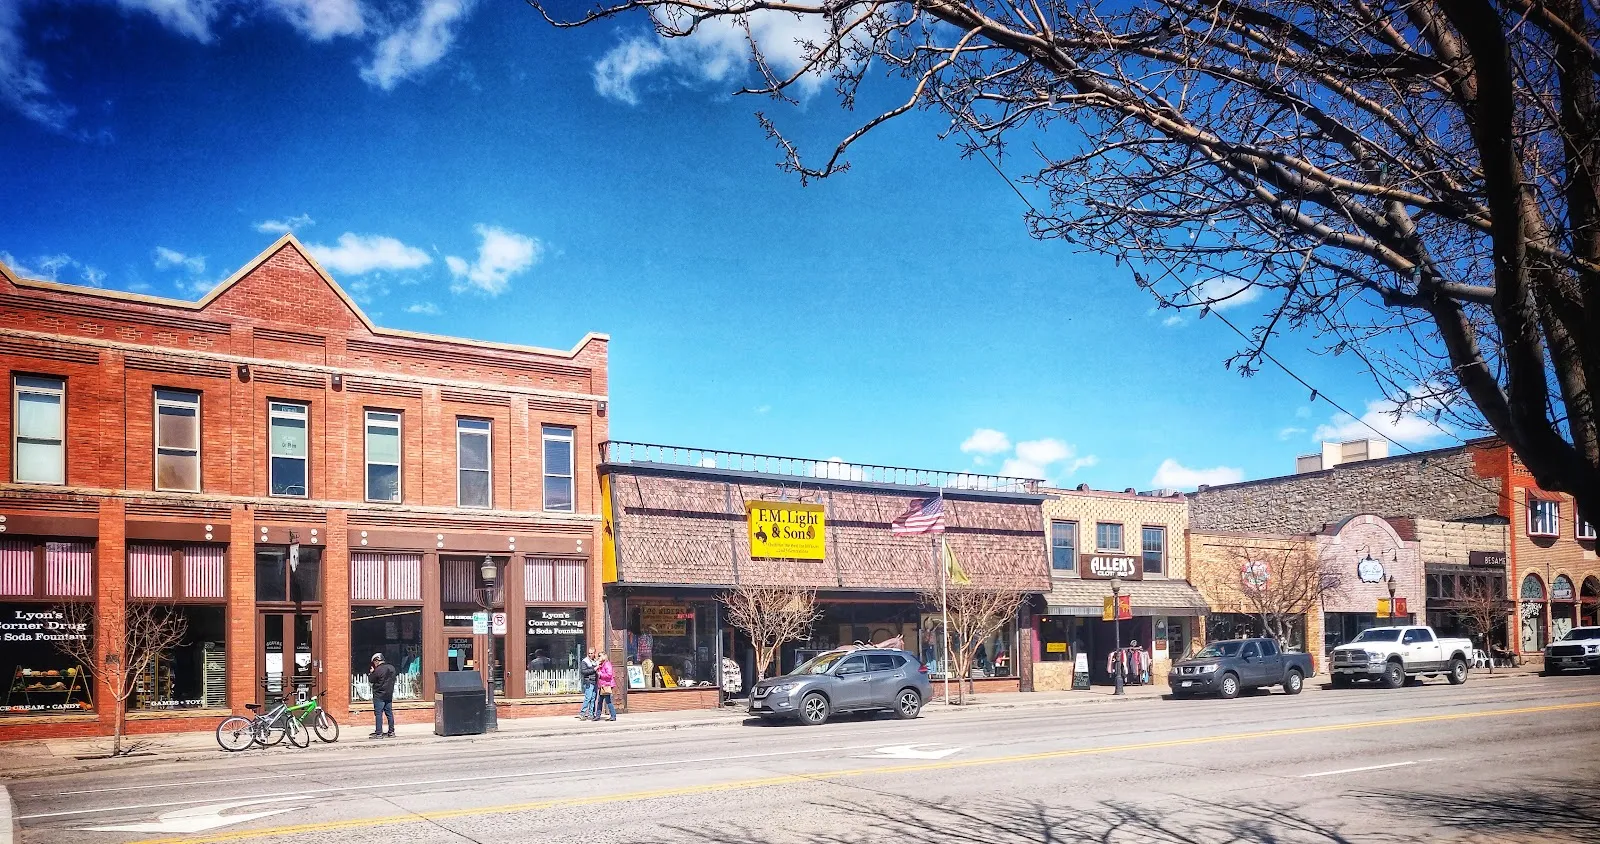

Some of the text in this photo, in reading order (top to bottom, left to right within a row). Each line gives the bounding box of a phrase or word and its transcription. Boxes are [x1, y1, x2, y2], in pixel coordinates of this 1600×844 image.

[759, 509, 818, 528] F.M. Light
[772, 525, 814, 540] & Sons
[1484, 556, 1506, 564] BESAME
[1091, 557, 1135, 575] ALLEN'S
[15, 610, 63, 620] Lyon's
[0, 621, 88, 631] orner Drug
[4, 633, 87, 641] Soda Fountain
